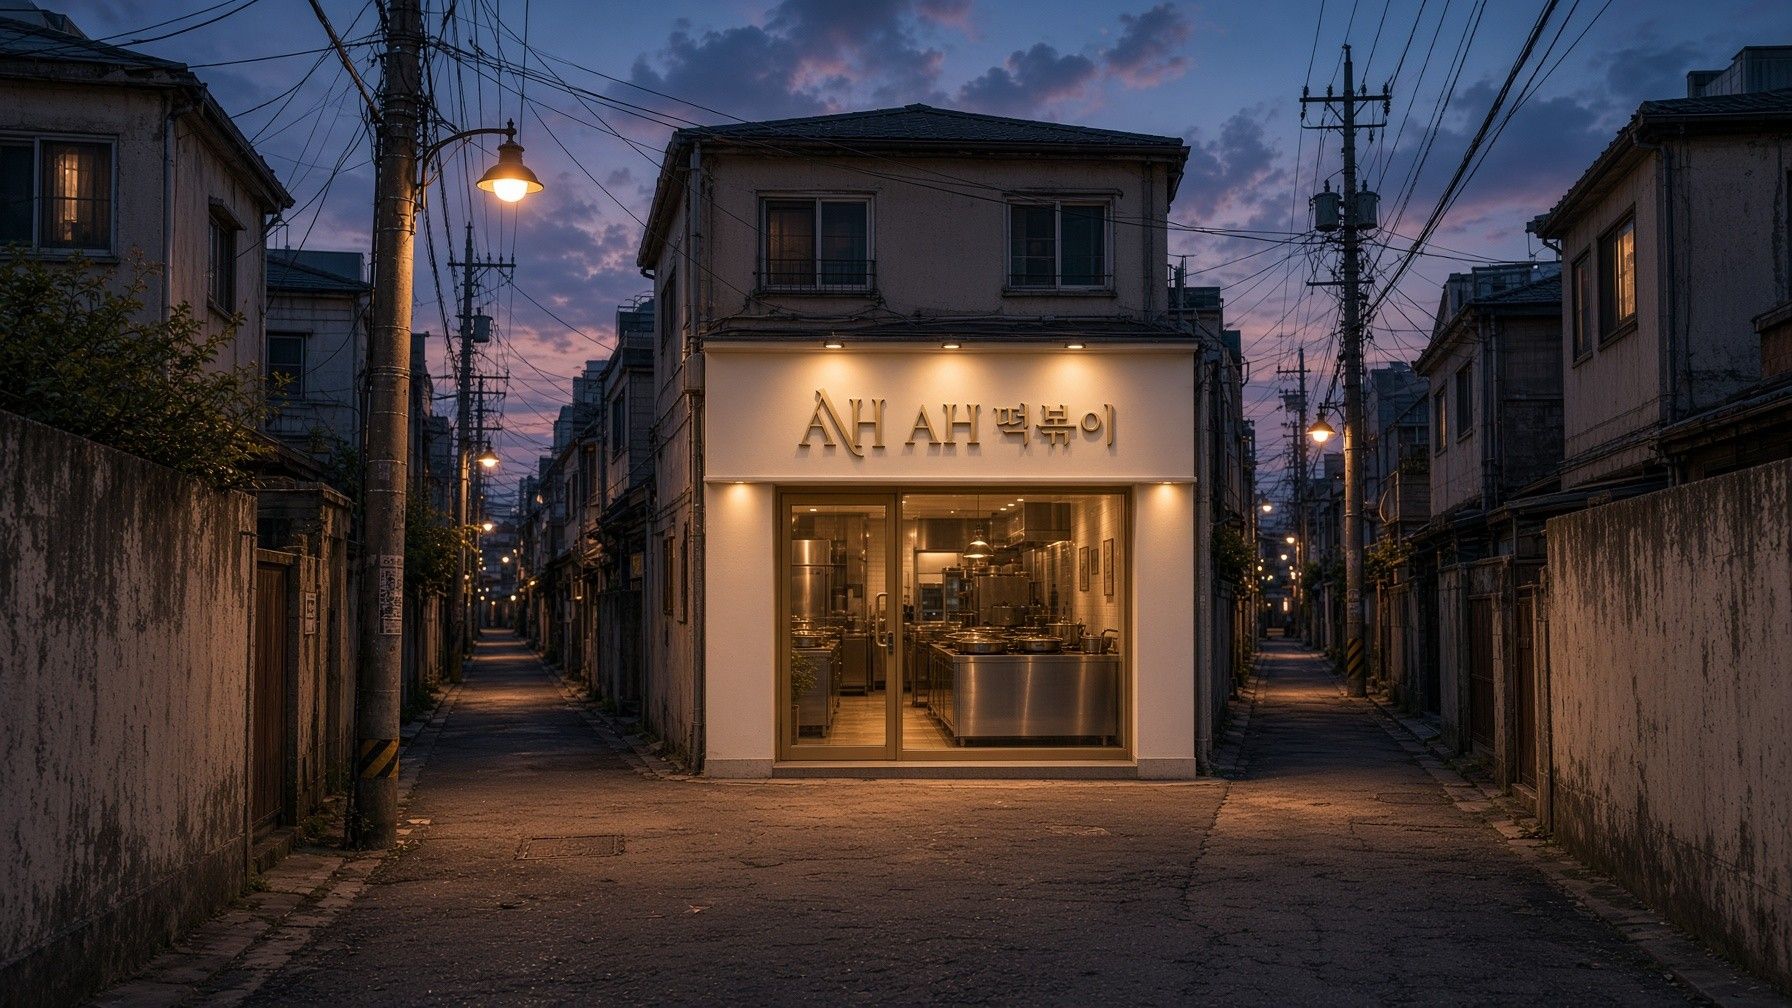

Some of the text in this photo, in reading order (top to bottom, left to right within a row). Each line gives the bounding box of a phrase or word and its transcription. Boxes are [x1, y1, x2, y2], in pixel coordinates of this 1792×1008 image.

[798, 388, 1114, 457] AH AH 떡볶이
